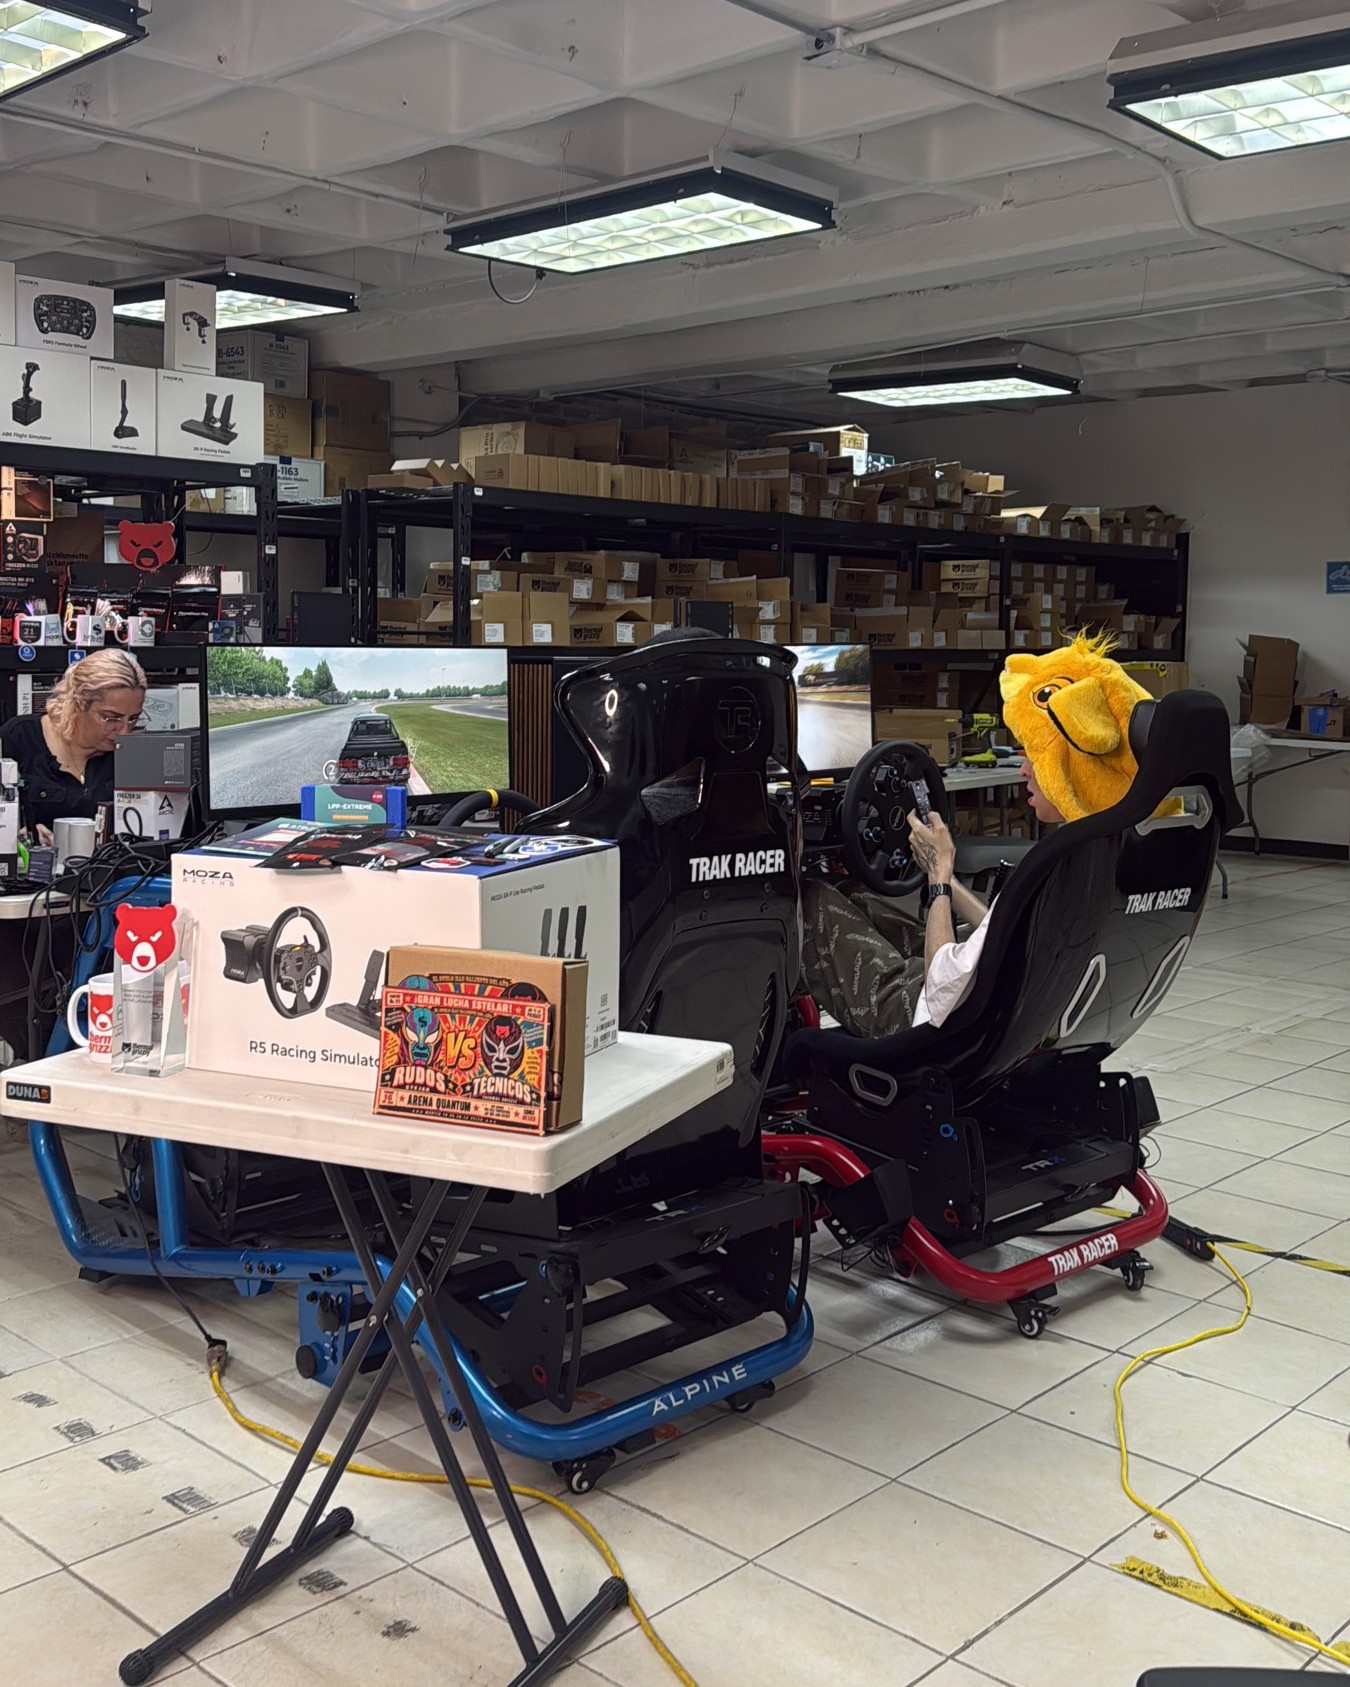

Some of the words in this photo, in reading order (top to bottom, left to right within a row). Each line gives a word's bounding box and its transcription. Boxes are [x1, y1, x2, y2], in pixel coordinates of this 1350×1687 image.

[328, 764, 335, 776] 2
[157, 808, 175, 816] ARCTIC
[183, 868, 234, 880] MOZA
[689, 853, 732, 883] TRAK
[734, 849, 785, 878] RACER
[183, 878, 235, 887] RACING
[520, 886, 533, 895] Racing
[1124, 891, 1157, 915] TRAK
[1153, 887, 1192, 911] RACER
[413, 994, 441, 1005] ¡GRAN
[443, 997, 469, 1009] LUCHA
[471, 1000, 513, 1013] ESTELAR!
[131, 1042, 154, 1051] thermal
[131, 1049, 151, 1057] grizzly
[249, 1040, 267, 1055] R5
[271, 1043, 317, 1064] Racing
[320, 1049, 380, 1069] Simulato
[446, 1030, 476, 1071] VS
[392, 1065, 446, 1094] RUDOS
[407, 1094, 434, 1108] ARENA
[435, 1098, 472, 1113] QUANTUM
[1047, 1247, 1082, 1276] TRAK
[1079, 1232, 1119, 1264] RACER
[651, 1362, 748, 1417] ALPINE
